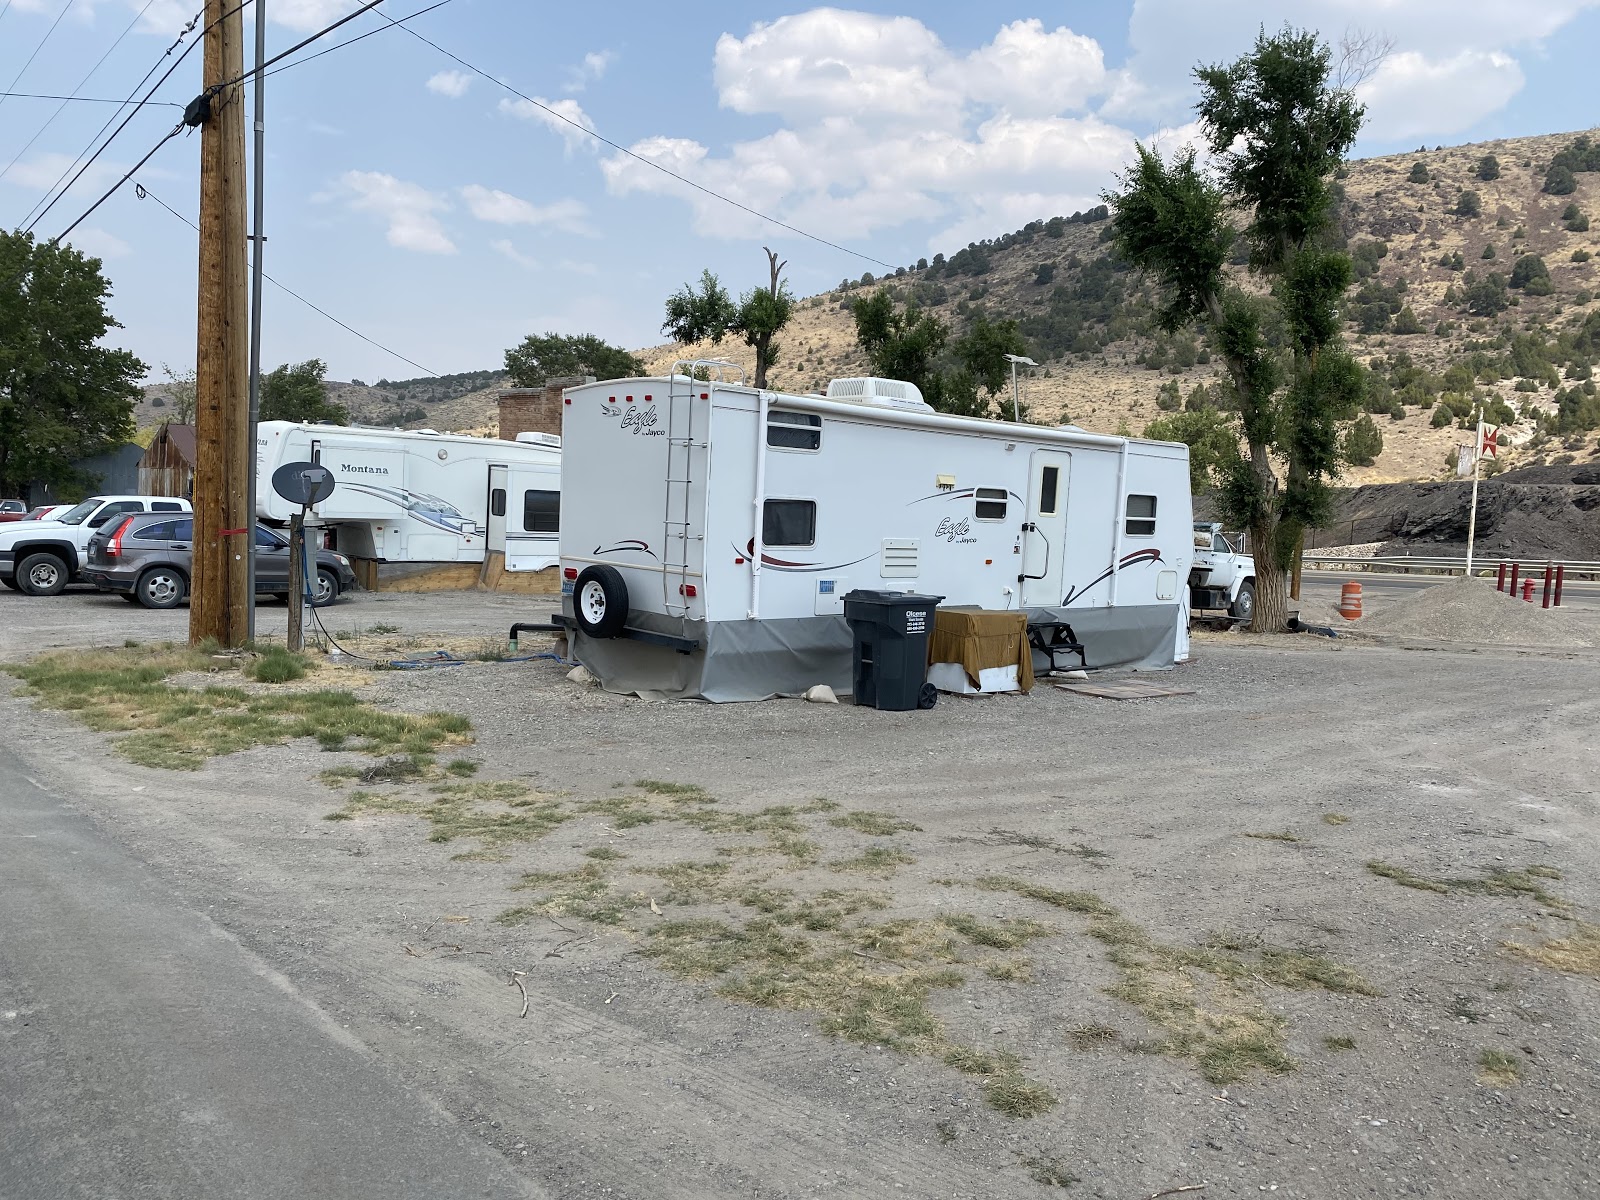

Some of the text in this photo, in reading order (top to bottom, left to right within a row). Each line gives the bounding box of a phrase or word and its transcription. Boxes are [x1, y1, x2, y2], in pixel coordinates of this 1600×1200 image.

[620, 404, 658, 435] Eagle
[645, 428, 666, 437] Jayco
[341, 463, 389, 475] Montana
[935, 516, 970, 543] Eagle
